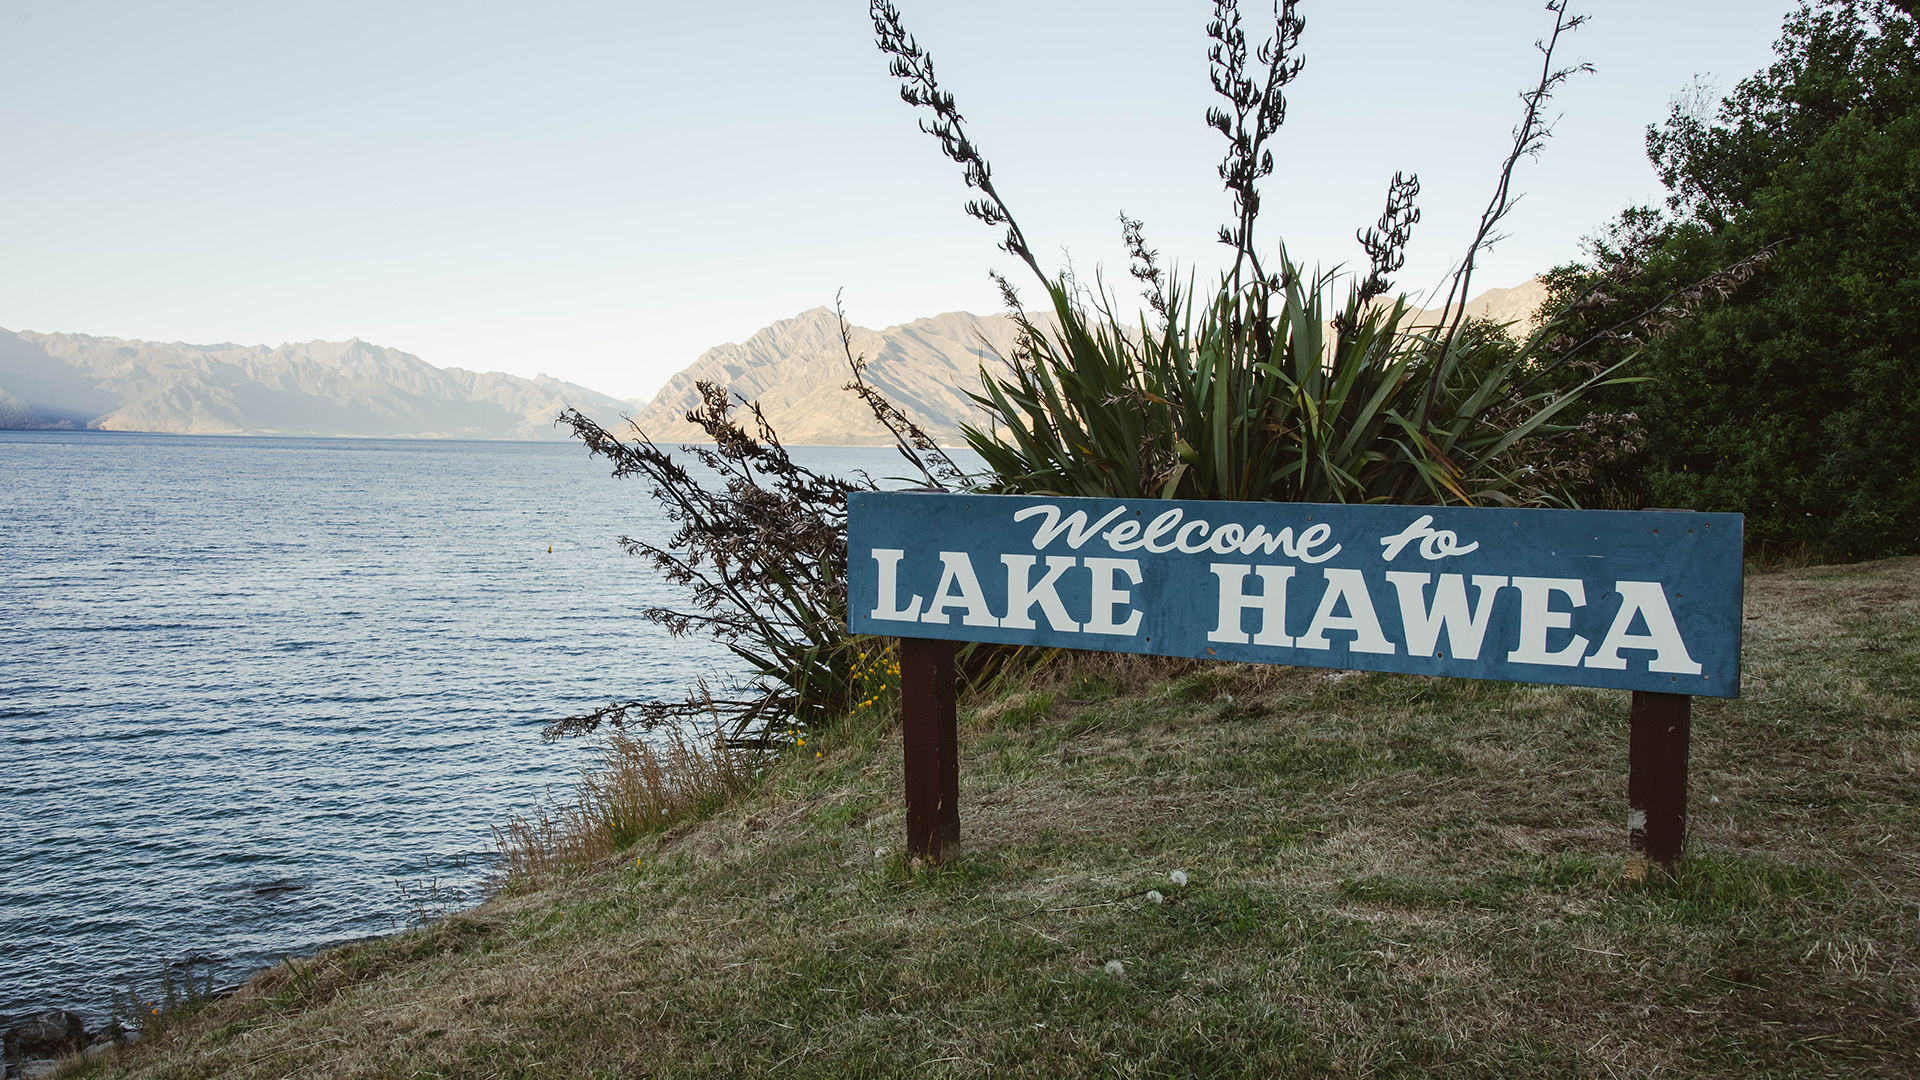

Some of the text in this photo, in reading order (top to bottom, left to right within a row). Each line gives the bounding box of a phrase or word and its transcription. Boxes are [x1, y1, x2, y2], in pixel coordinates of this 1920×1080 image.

[1013, 504, 1479, 564] Welcome to
[870, 548, 1702, 675] LAKE HAWEA
